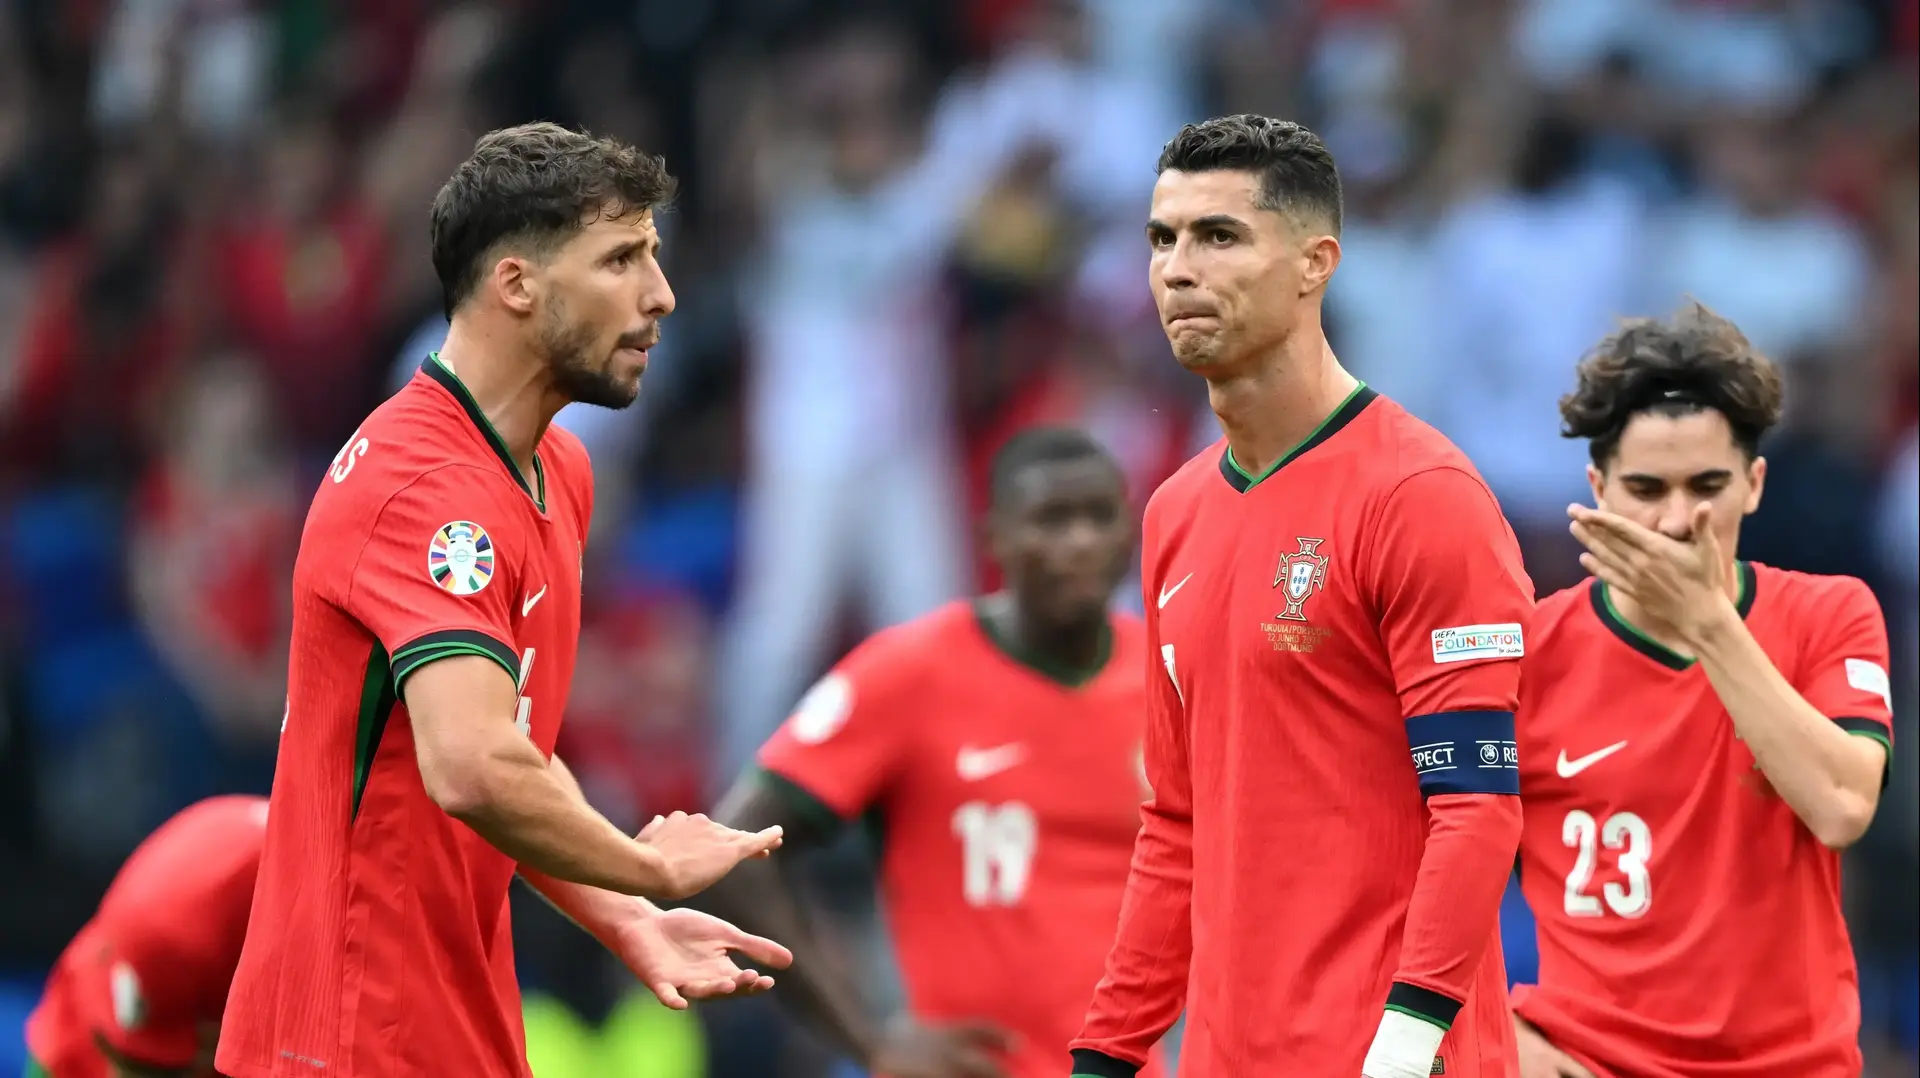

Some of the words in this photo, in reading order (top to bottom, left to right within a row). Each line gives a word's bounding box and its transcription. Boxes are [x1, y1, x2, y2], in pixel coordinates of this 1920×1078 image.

[1267, 632, 1275, 642] 22
[1277, 633, 1300, 643] JUNHO
[1434, 630, 1456, 639] UEFA
[1412, 747, 1455, 769] SPECT
[1503, 746, 1518, 763] RE
[951, 800, 1039, 908] 19
[1561, 809, 1653, 920] 23
